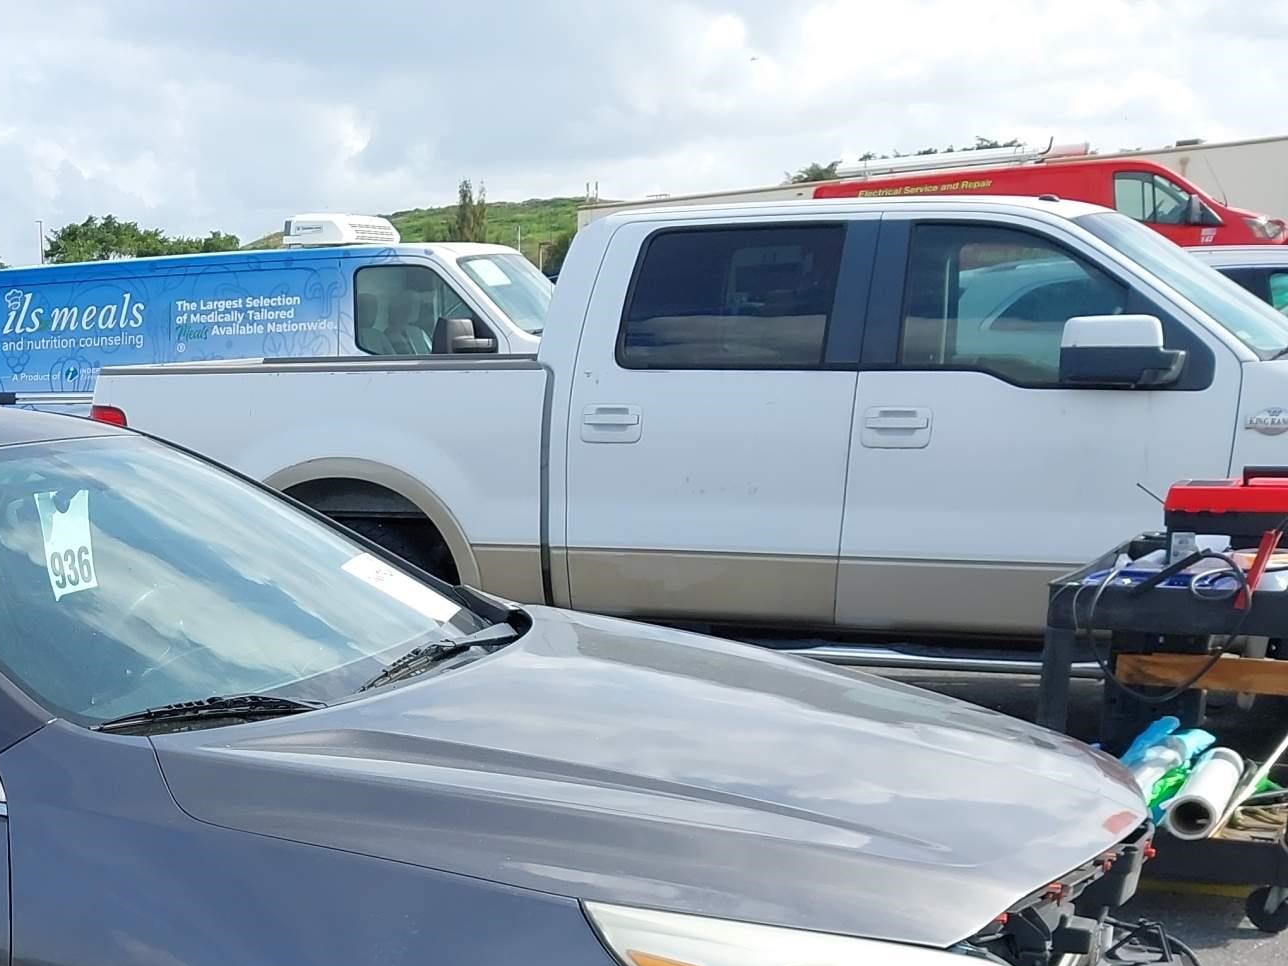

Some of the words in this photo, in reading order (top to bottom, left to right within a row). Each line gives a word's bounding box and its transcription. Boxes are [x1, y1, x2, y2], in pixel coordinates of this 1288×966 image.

[858, 188, 902, 198] Electrical
[903, 184, 938, 194] Service
[940, 181, 960, 191] and
[961, 179, 992, 190] Repair
[175, 300, 197, 311] The
[200, 296, 243, 311] Largest
[246, 294, 301, 306] Selection
[3, 292, 44, 335] ils
[50, 292, 145, 332] meals
[175, 312, 188, 324] of
[190, 310, 245, 323] Medically
[247, 308, 295, 321] Tailored
[211, 323, 264, 336] Available
[266, 319, 338, 333] Nationwide.
[2, 338, 24, 352] and
[27, 335, 76, 350] nutrition
[79, 331, 145, 349] counseling
[12, 373, 19, 382] A
[20, 372, 51, 382] Product
[52, 371, 61, 381] of
[50, 546, 92, 589] 936
